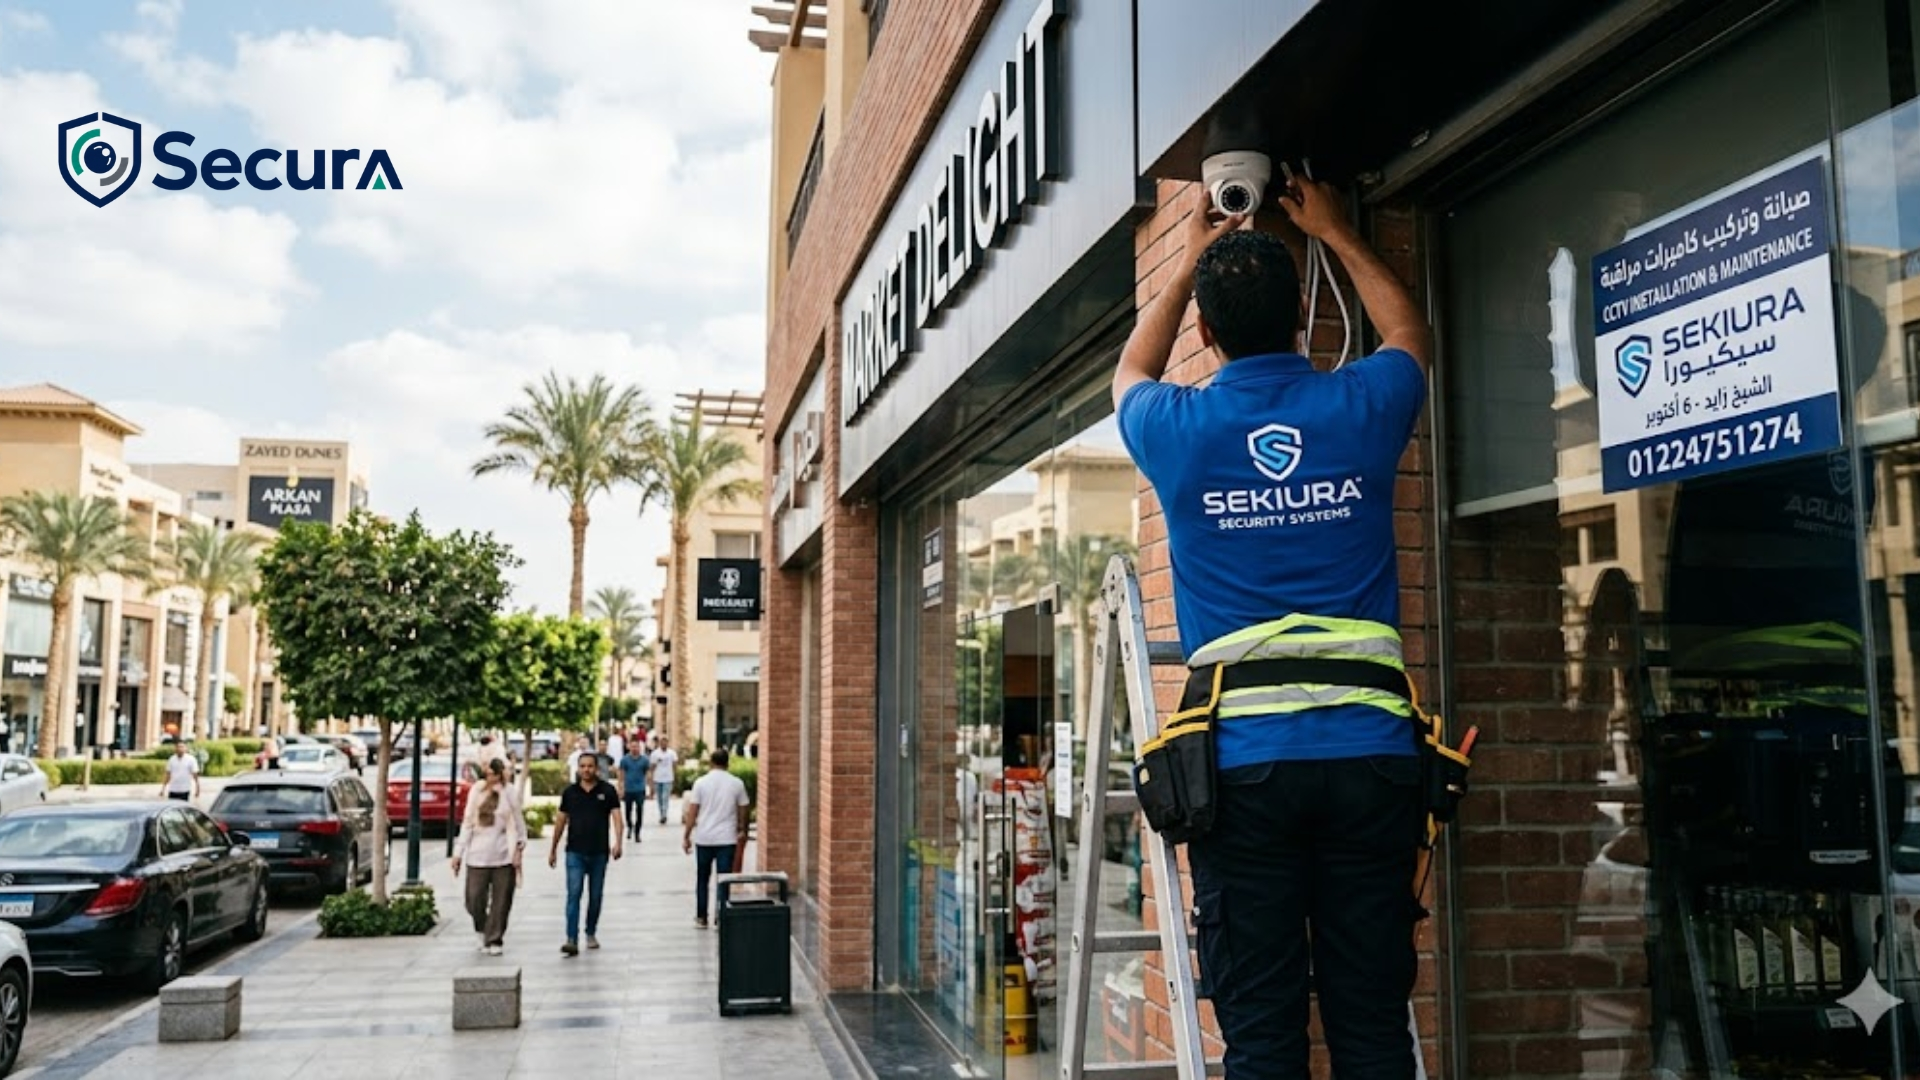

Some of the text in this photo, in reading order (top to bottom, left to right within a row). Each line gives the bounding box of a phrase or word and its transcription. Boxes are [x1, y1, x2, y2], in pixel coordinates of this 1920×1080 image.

[842, 0, 1054, 427] MARKET DELIGHT
[1600, 190, 1811, 291] صيانة وتركيب كاميرات مراقبة
[1602, 299, 1629, 323] CCTV
[1708, 264, 1719, 285] &
[1720, 227, 1813, 280] MAINTENANCE
[1662, 286, 1806, 356] SEKIURA
[1664, 334, 1776, 387] سيكيورا
[1683, 397, 1692, 415] 6
[1705, 386, 1728, 411] زايد
[1731, 374, 1773, 408] الشيخ
[1645, 393, 1680, 428] أكتوبر
[245, 444, 343, 460] ZAYED DUNES
[1628, 411, 1802, 478] 01224751274
[262, 487, 321, 503] ARKAN
[1218, 506, 1351, 530] SECURITY SYSTEMS
